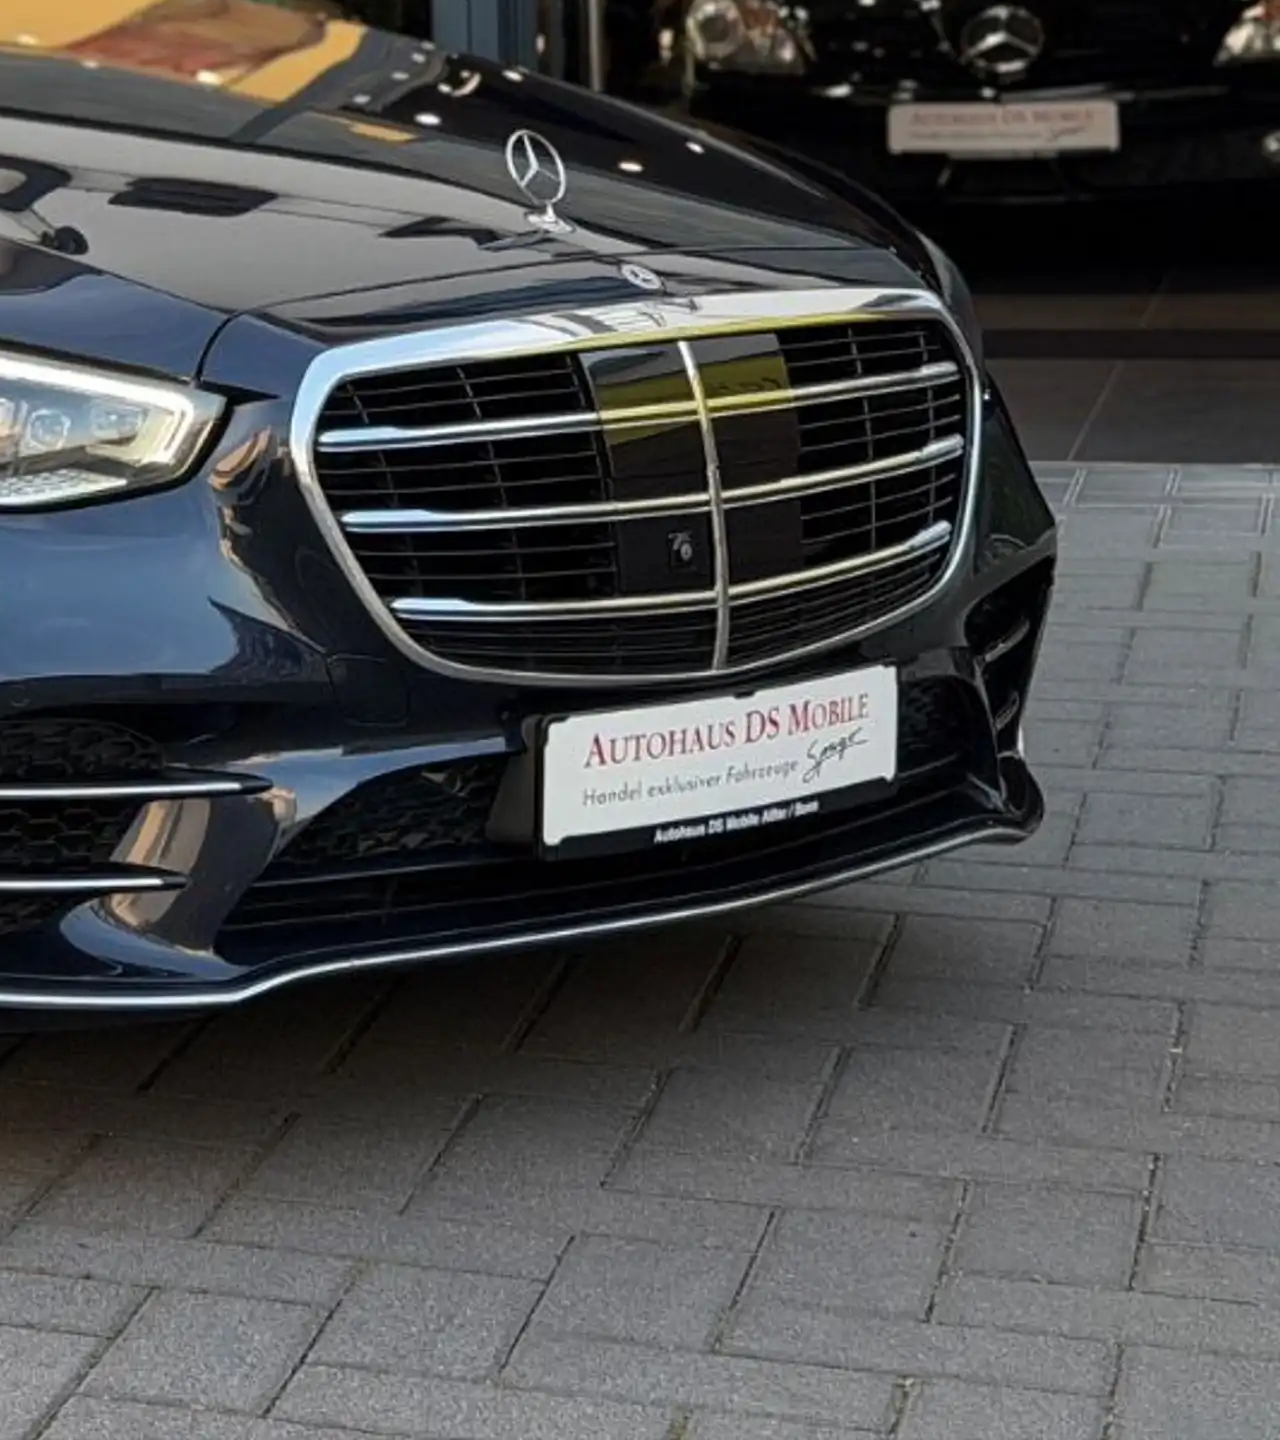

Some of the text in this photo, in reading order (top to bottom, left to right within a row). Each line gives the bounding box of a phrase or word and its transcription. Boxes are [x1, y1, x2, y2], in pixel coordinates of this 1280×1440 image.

[584, 693, 870, 769] AUTOHAUS DS MOBILE
[583, 759, 799, 807] Handel exklusiver Fahrzeuge
[654, 823, 706, 844] Autohaus
[708, 818, 724, 834] DS
